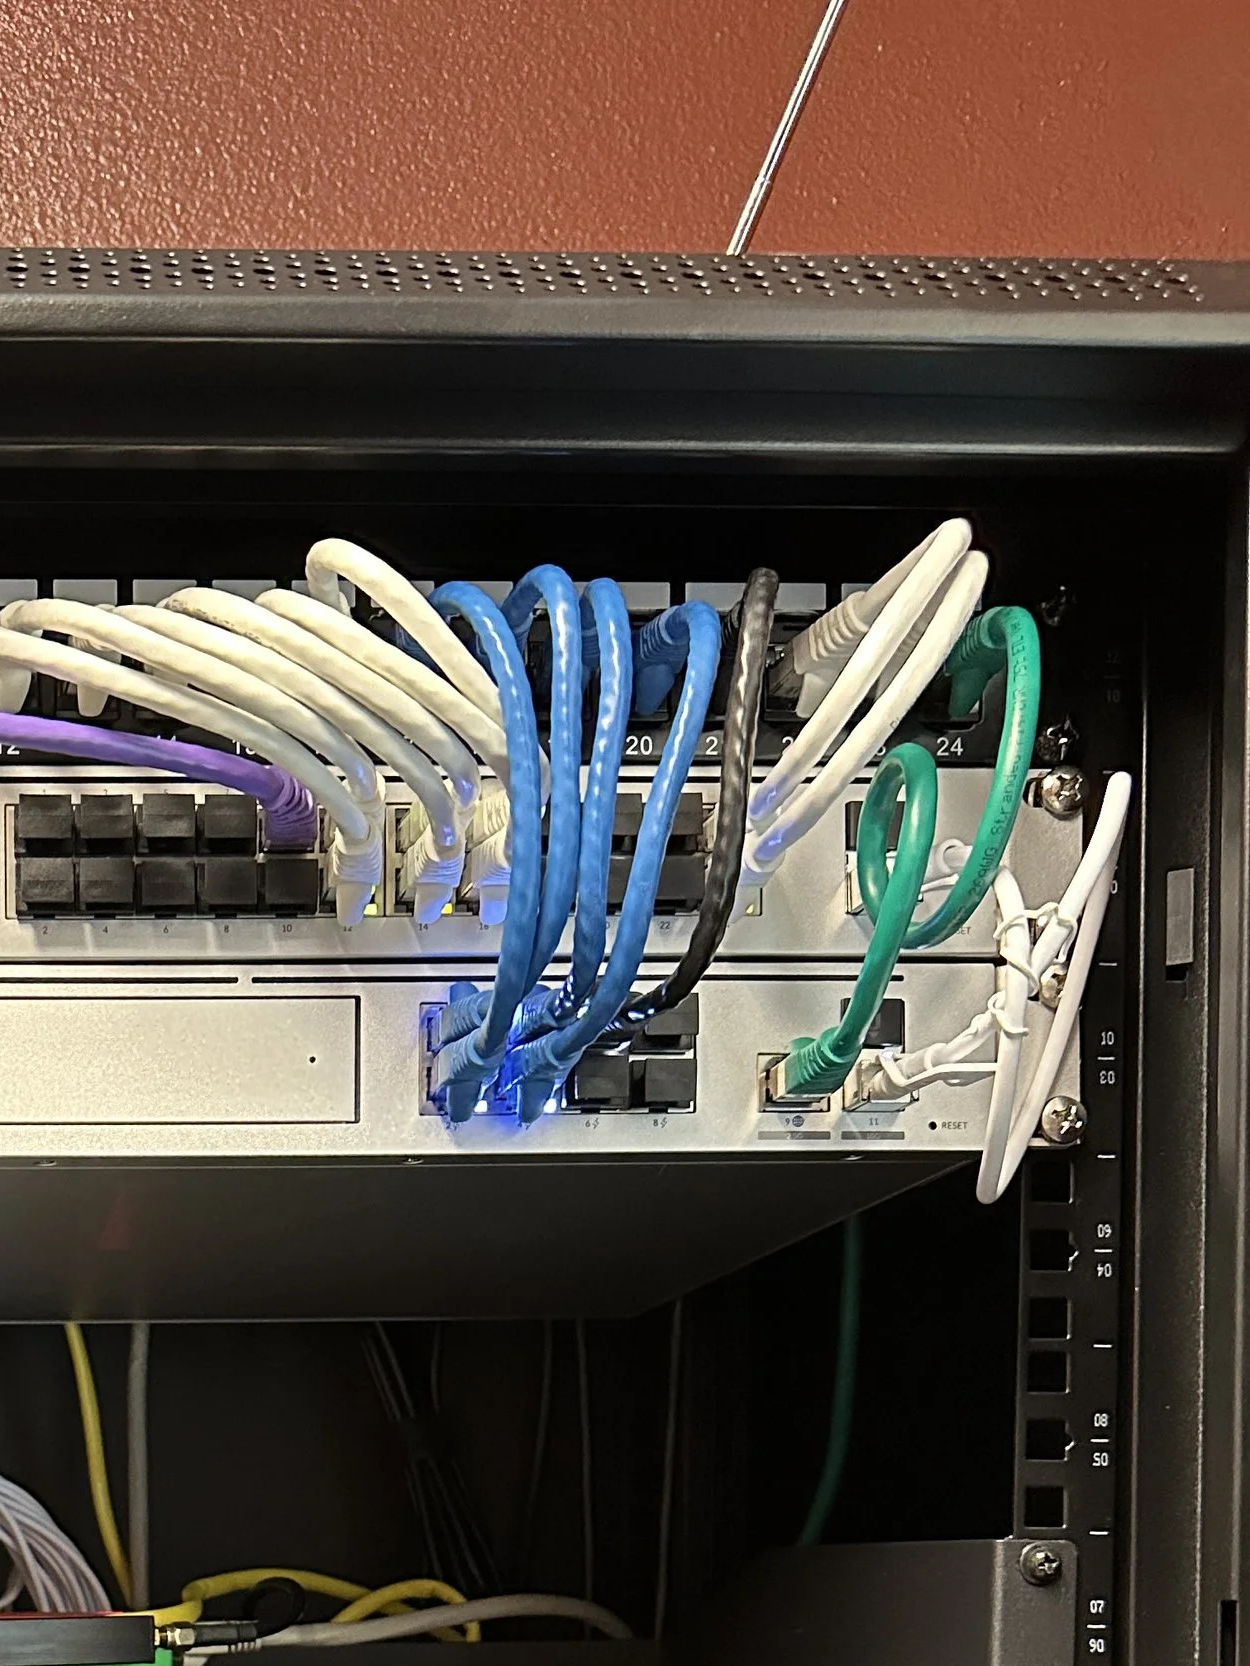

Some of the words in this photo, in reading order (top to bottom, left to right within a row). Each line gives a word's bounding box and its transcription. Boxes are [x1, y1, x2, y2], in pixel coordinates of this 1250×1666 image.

[625, 735, 653, 756] 20
[936, 736, 964, 757] 24
[42, 925, 49, 934] 2
[102, 924, 109, 934] 4
[163, 924, 170, 934] 6
[223, 924, 230, 934] 8
[281, 923, 293, 933] 10
[660, 921, 671, 930] 22
[1101, 1031, 1115, 1045] 10
[585, 1118, 591, 1128] 6
[652, 1118, 659, 1127] 8
[784, 1117, 791, 1127] 9
[868, 1117, 879, 1126] 11
[941, 1121, 969, 1131] RESET
[1097, 1223, 1112, 1238] 09
[1093, 1413, 1108, 1427] 08
[1089, 1599, 1105, 1614] 07
